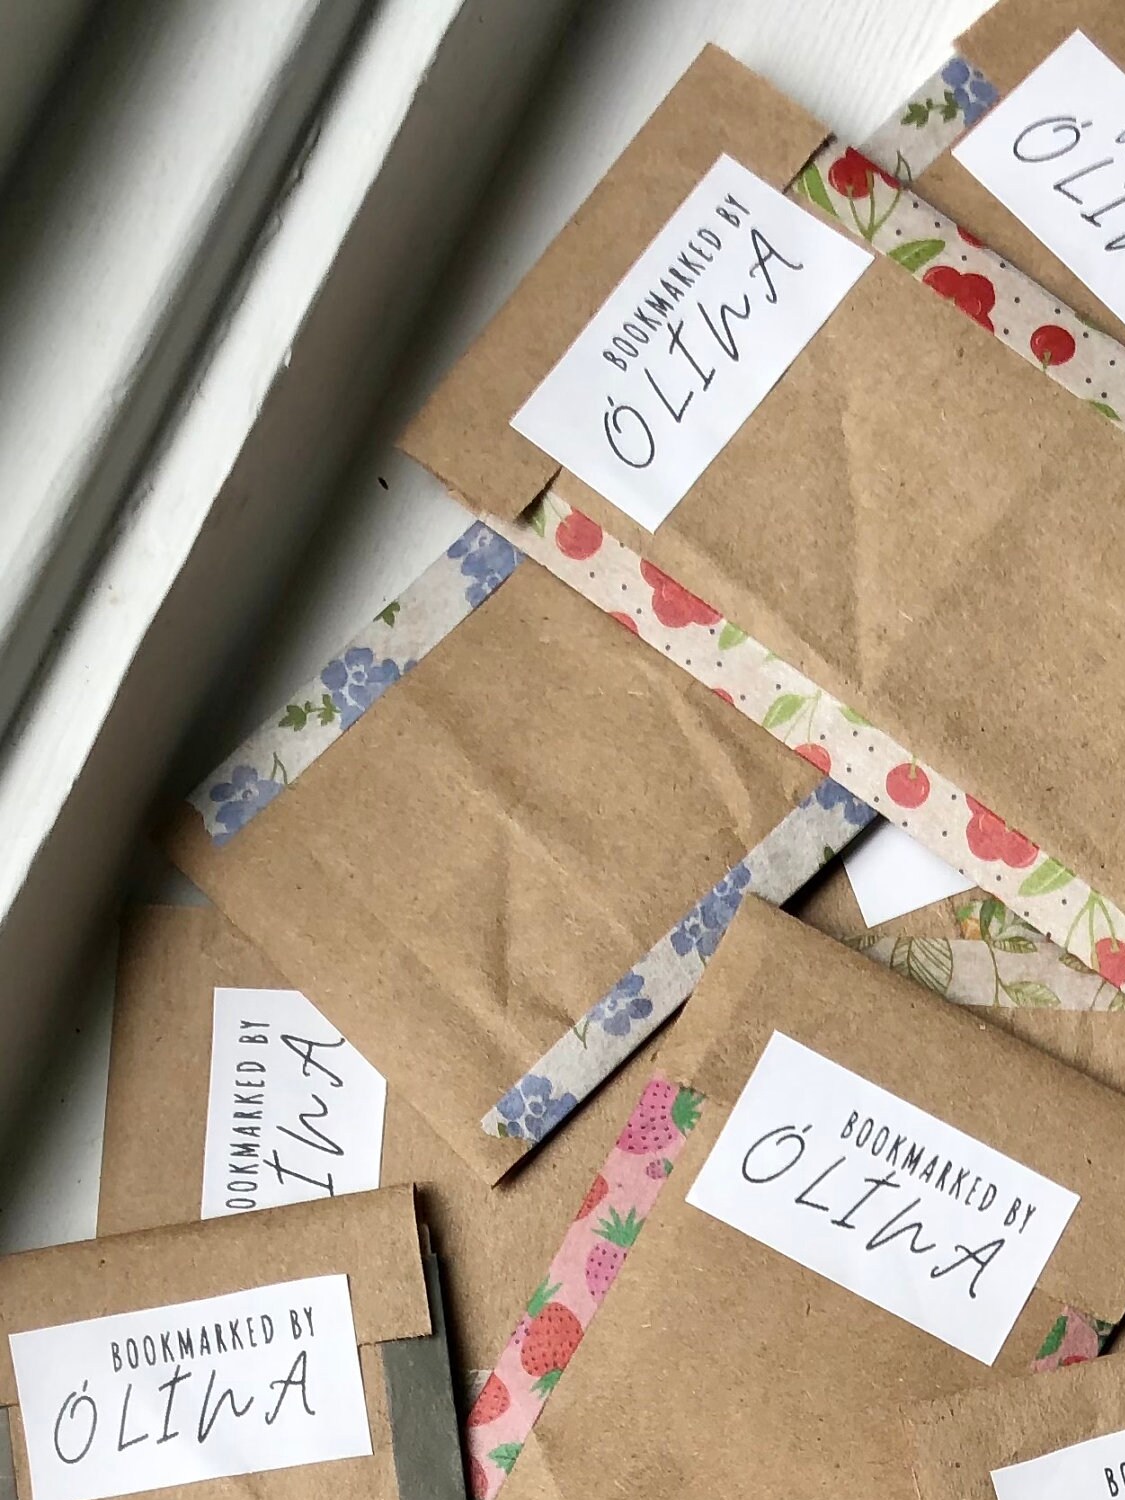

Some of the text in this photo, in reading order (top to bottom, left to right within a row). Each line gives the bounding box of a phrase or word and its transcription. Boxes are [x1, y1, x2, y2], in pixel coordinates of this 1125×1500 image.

[602, 193, 751, 371] BOOKMARKED BY
[226, 1020, 270, 1209] OOKMARKED BY
[840, 1111, 1036, 1234] BOOKMARKED BY
[111, 1307, 315, 1372] BOOKMARKED BY
